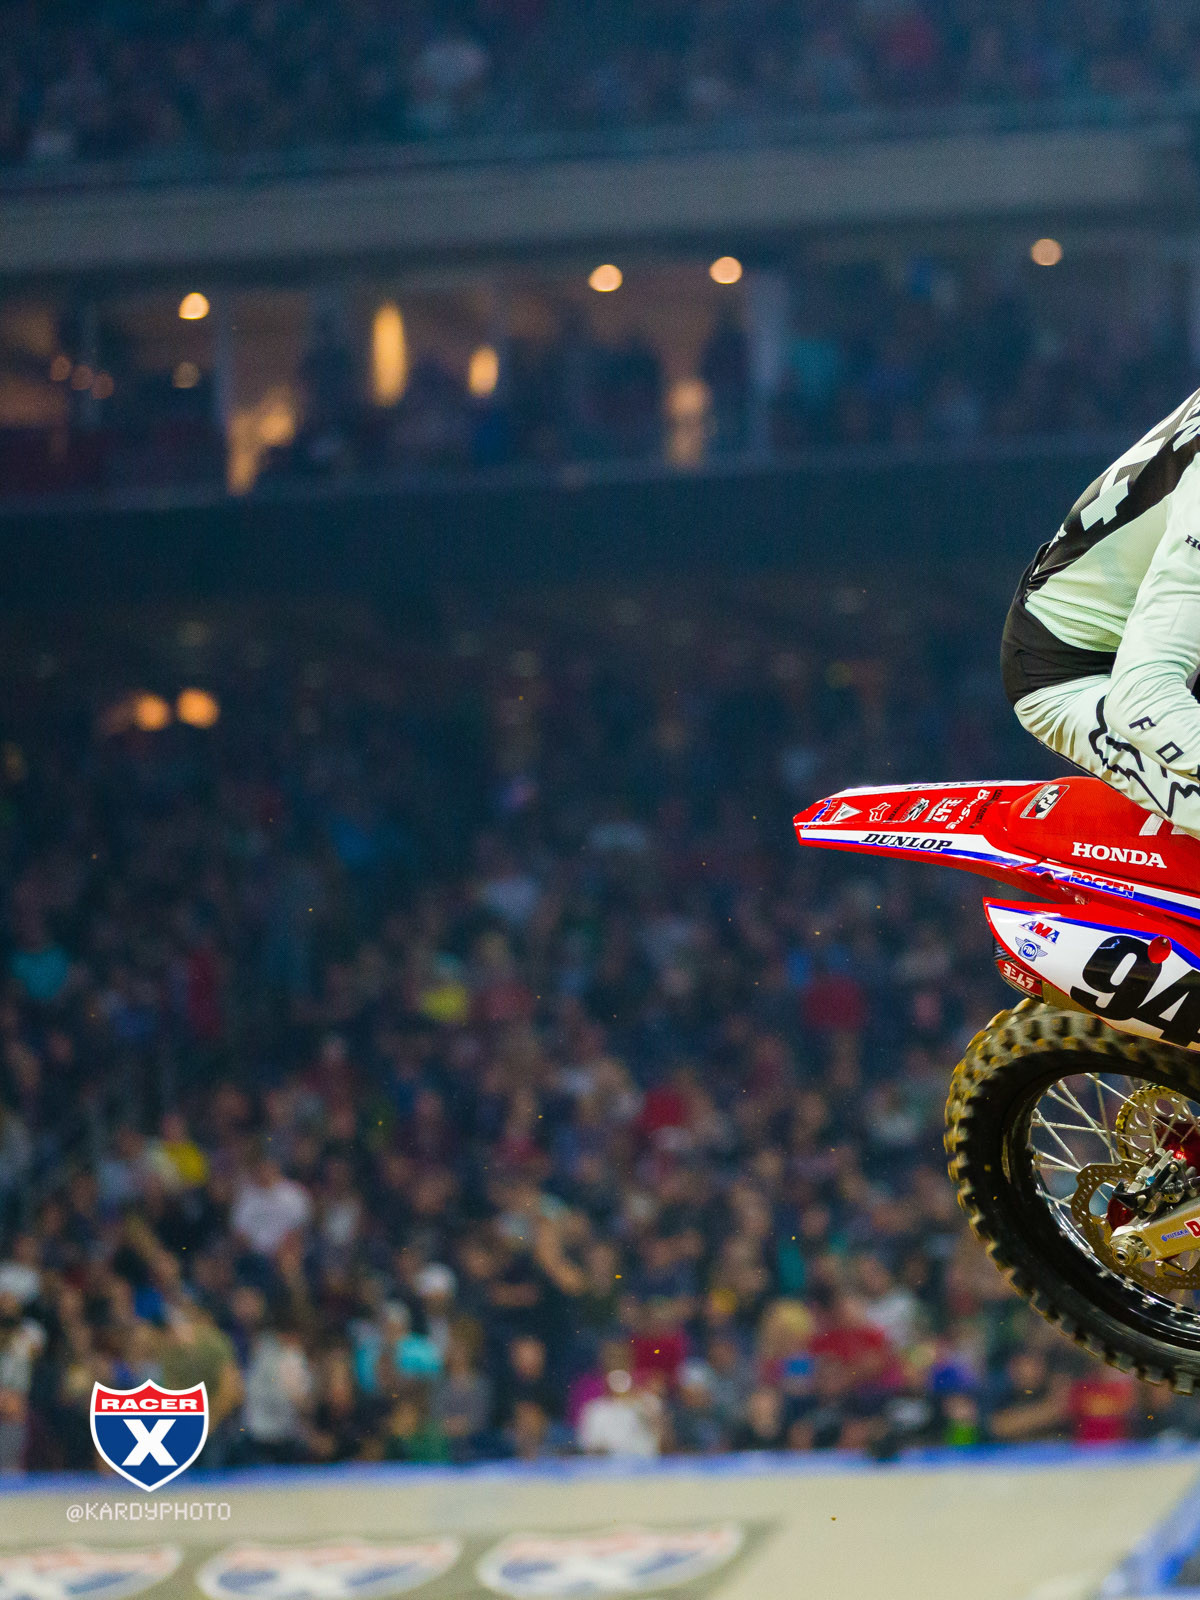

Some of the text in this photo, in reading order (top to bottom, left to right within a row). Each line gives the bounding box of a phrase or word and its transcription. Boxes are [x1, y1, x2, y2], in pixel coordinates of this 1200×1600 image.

[860, 832, 953, 852] DUNLOP
[1071, 841, 1168, 869] HONDA
[1069, 871, 1134, 898] ROCZEN
[1020, 920, 1061, 944] AMA
[1002, 962, 1035, 990] ヨシムラ
